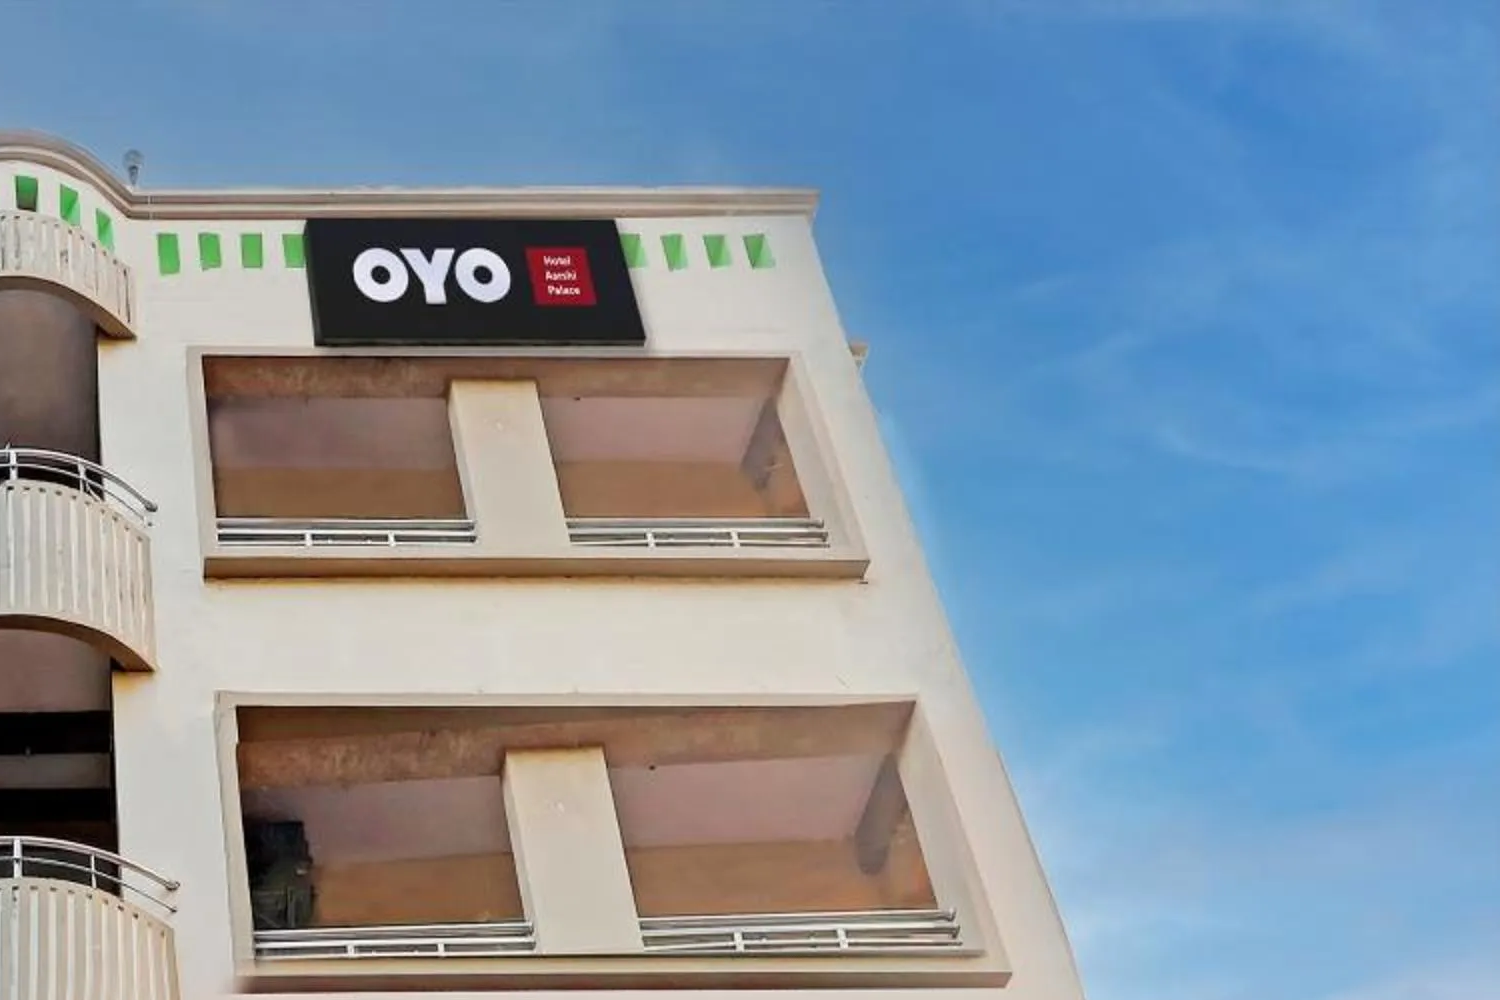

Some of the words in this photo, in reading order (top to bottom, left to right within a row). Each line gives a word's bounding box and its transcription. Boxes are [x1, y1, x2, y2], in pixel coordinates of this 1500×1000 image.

[543, 254, 570, 266] Hotel
[352, 247, 512, 305] OYO
[547, 284, 581, 296] Palace
